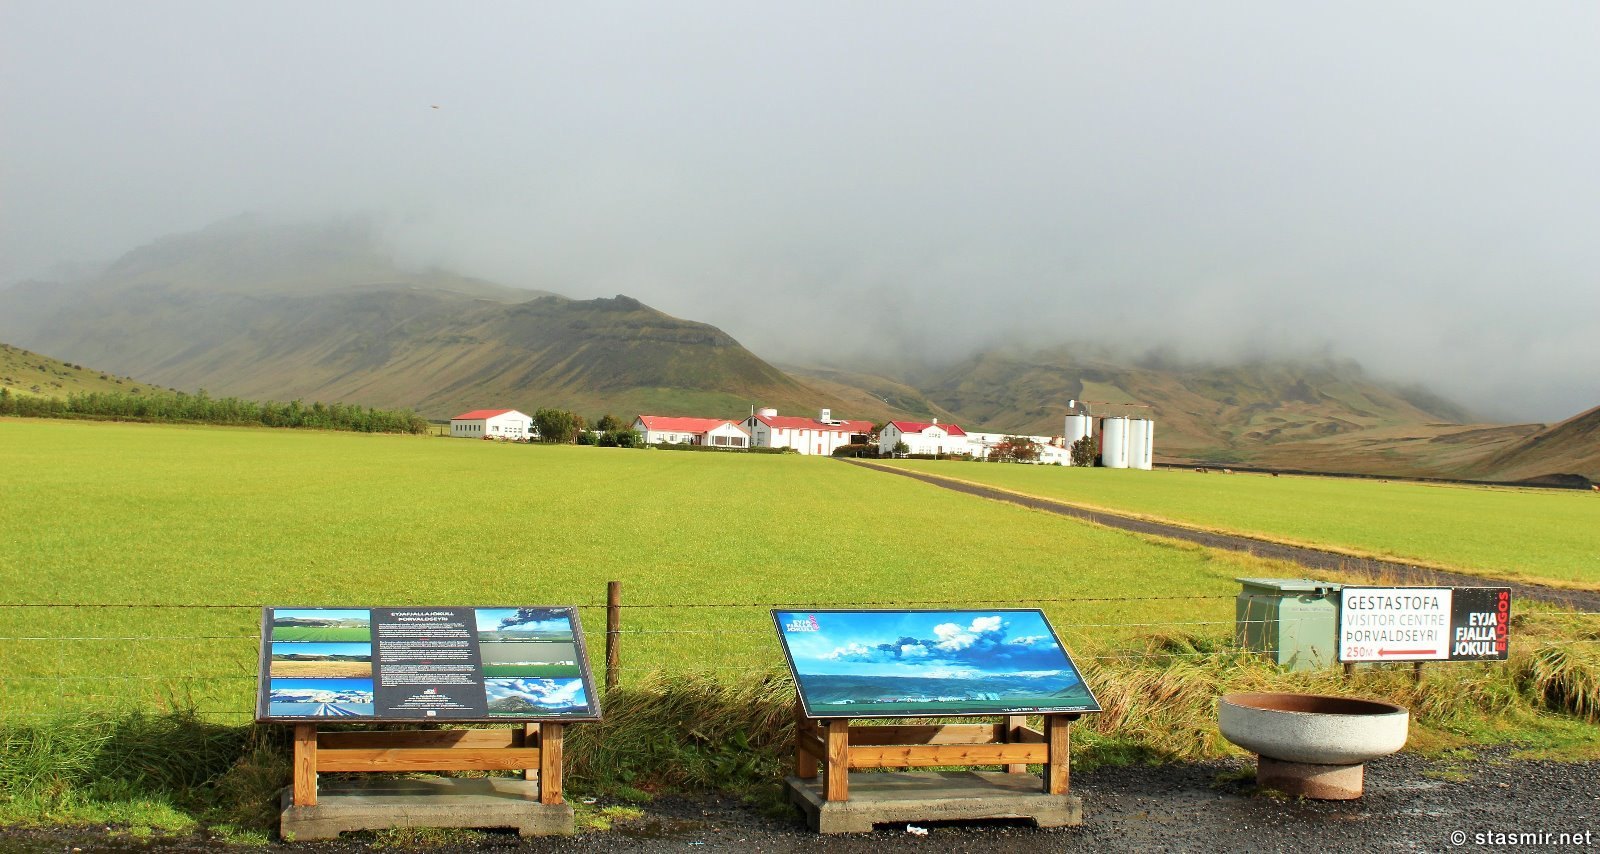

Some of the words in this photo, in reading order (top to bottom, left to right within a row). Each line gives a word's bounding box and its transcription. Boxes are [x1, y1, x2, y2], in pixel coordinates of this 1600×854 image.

[1347, 596, 1439, 610] GESTASTOFA
[1346, 614, 1395, 626] VISITOR
[1399, 614, 1445, 626] CENTRE
[1469, 612, 1498, 626] EYJA
[1496, 591, 1509, 651] ELDGOS
[1346, 630, 1438, 642] ÞORVALDSEYRI
[1455, 627, 1497, 641] FJALLA
